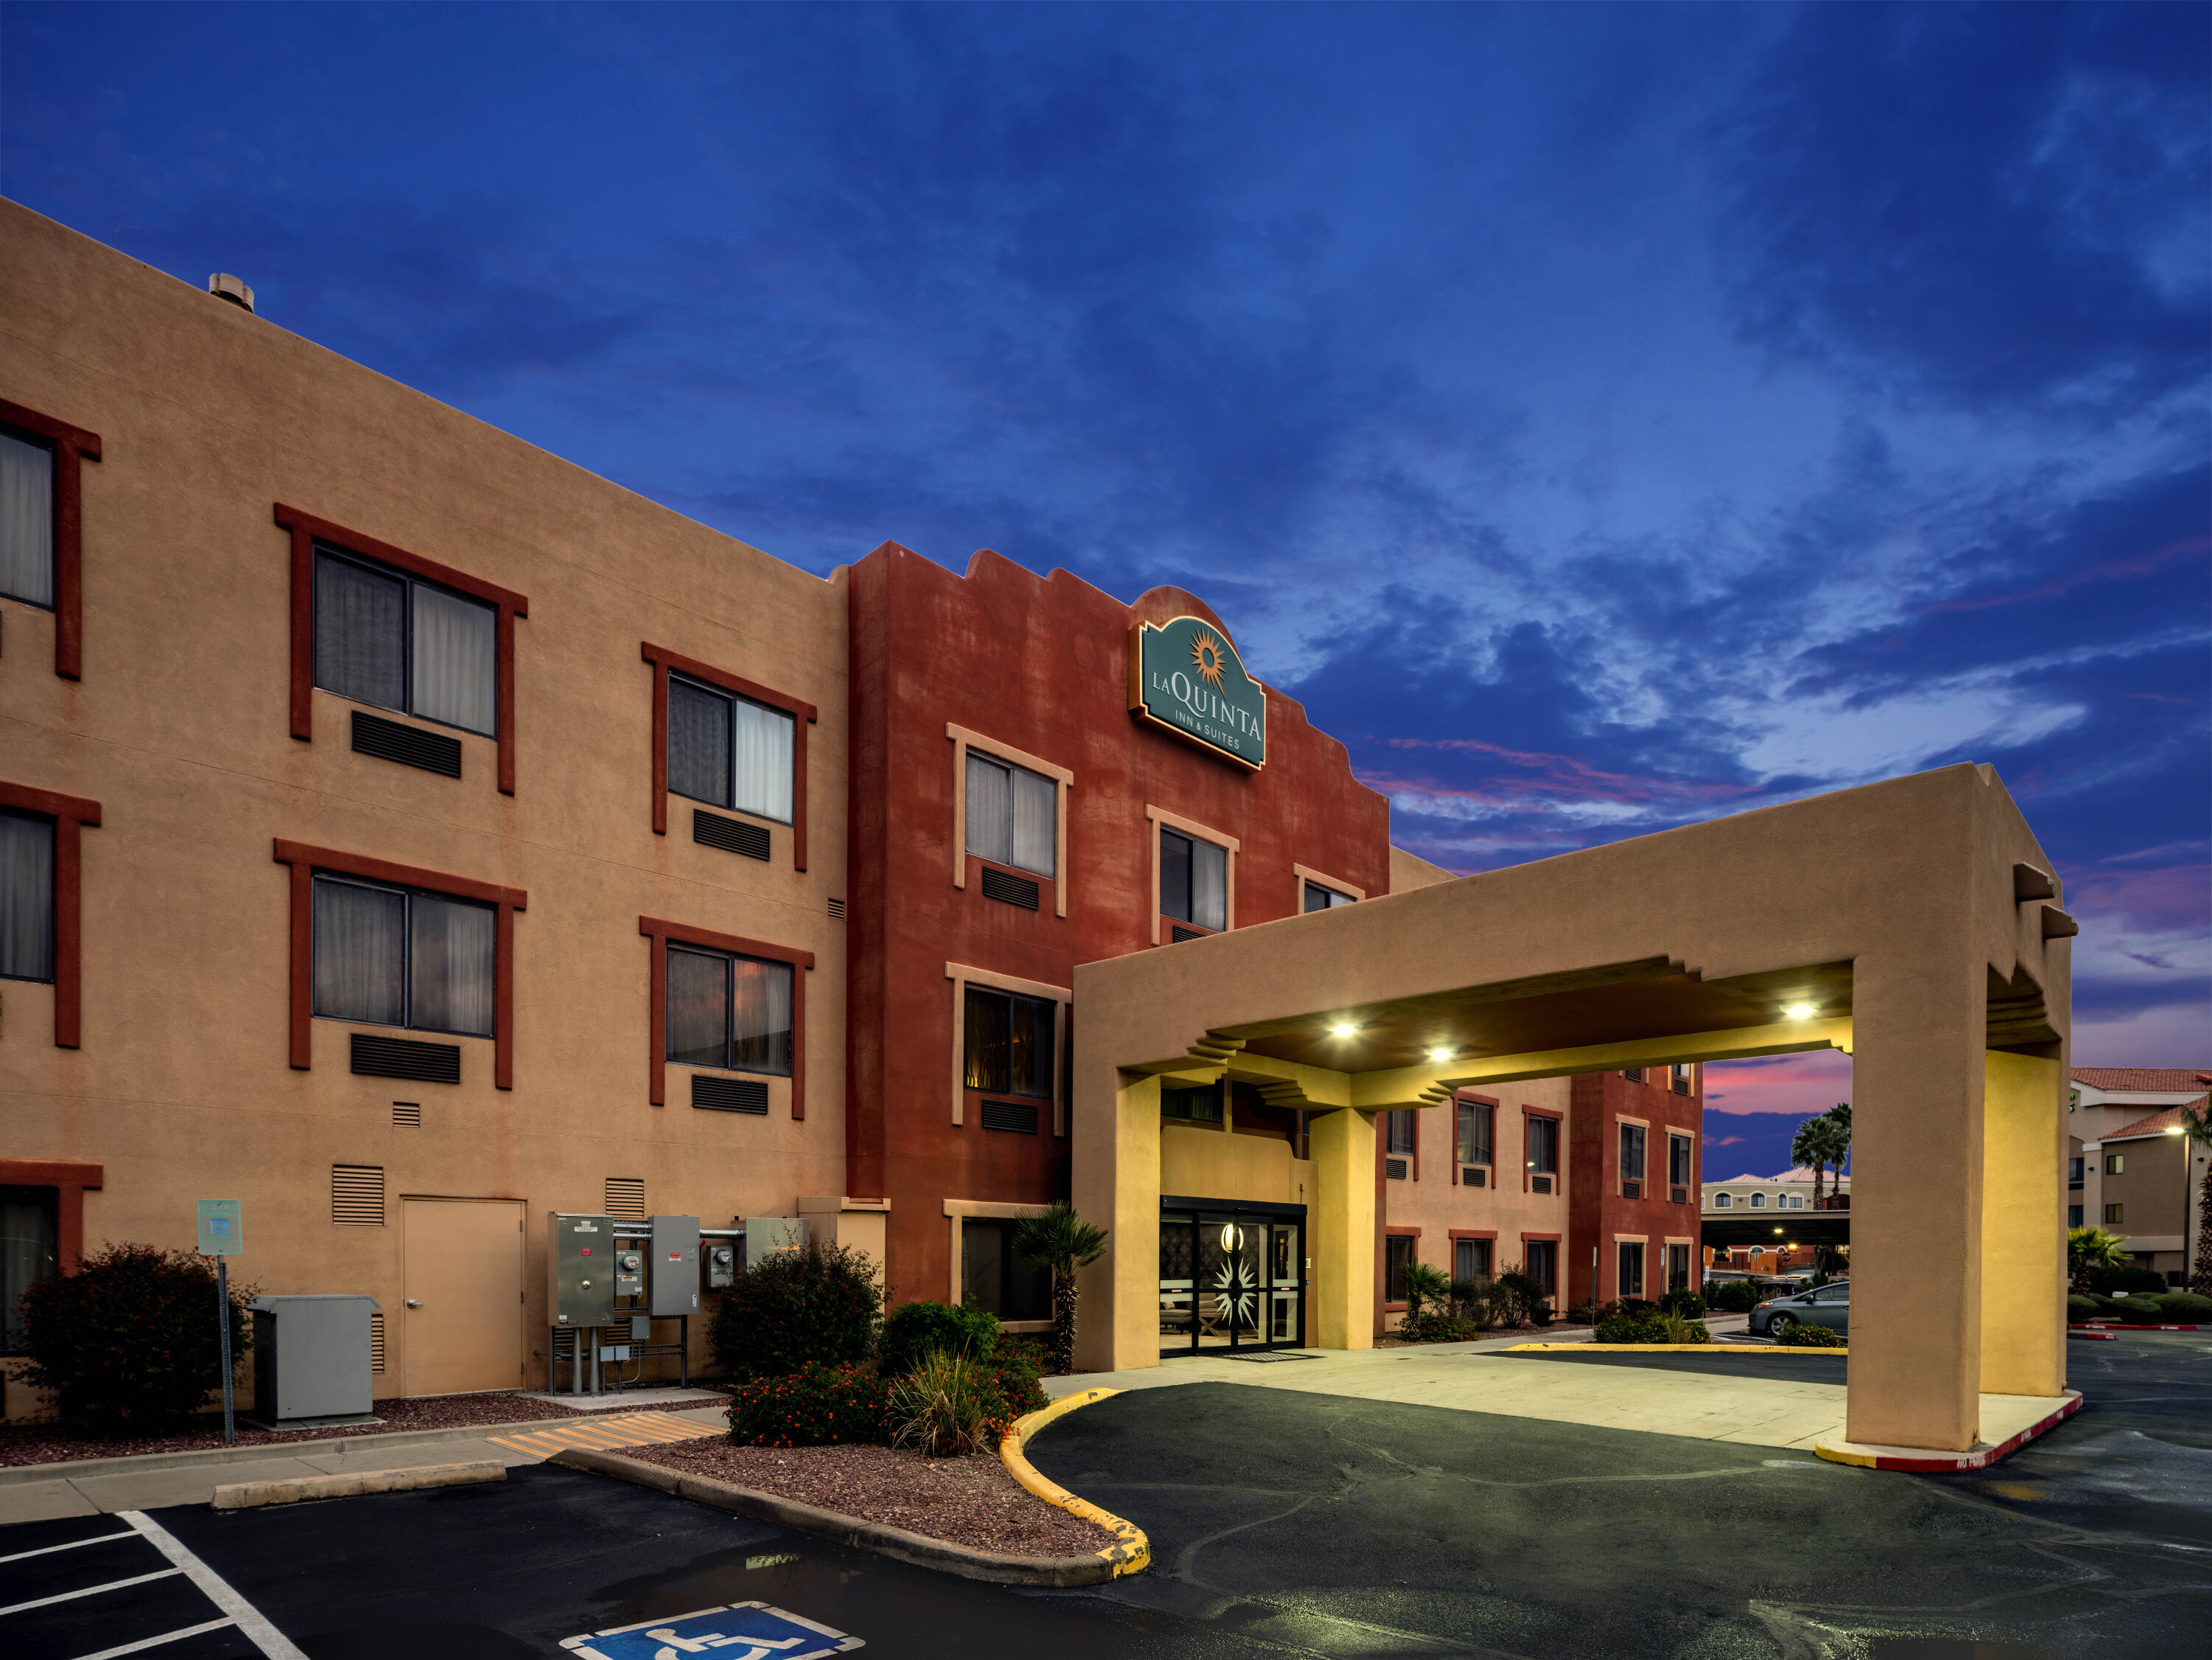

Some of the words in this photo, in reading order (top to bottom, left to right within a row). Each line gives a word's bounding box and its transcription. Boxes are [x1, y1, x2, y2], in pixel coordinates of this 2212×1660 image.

[1172, 672, 1262, 742] QUINTA
[1175, 709, 1193, 727] INN
[1196, 722, 1201, 732] &
[1204, 724, 1239, 749] SUITES
[1957, 1457, 1967, 1469] NO
